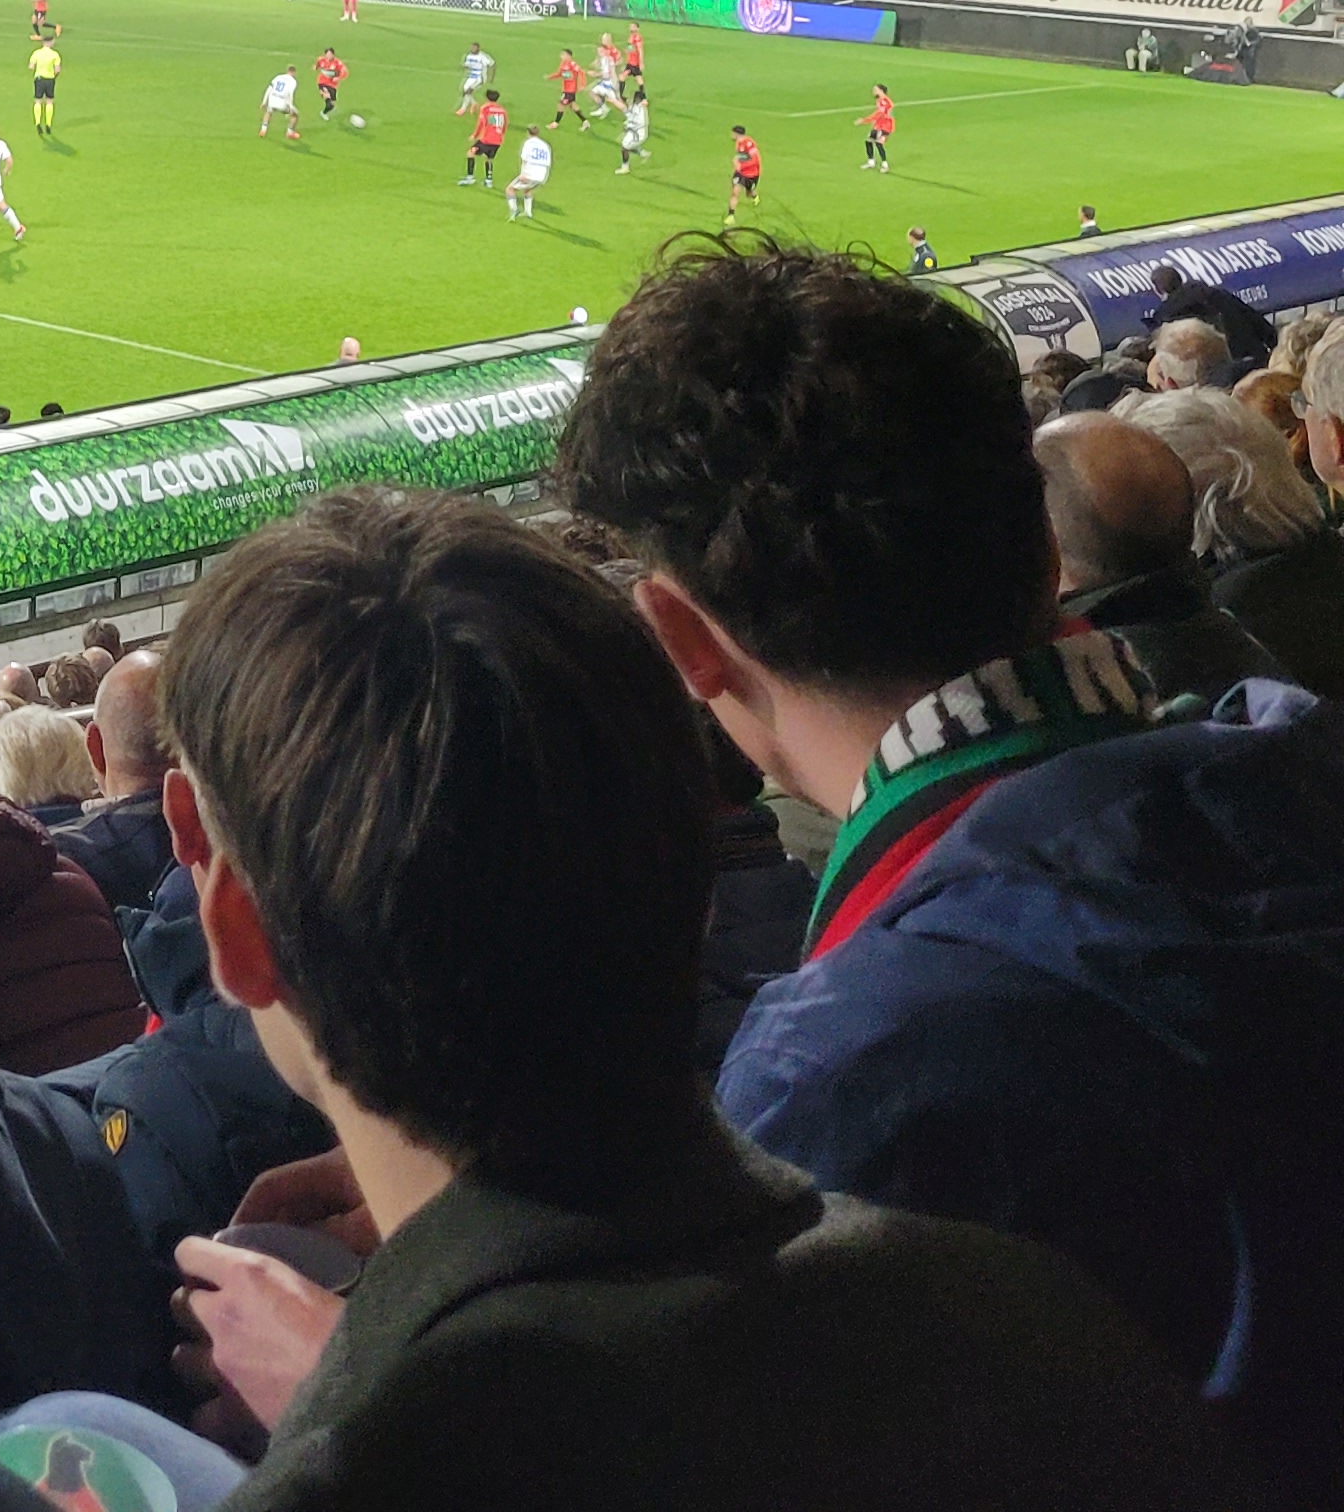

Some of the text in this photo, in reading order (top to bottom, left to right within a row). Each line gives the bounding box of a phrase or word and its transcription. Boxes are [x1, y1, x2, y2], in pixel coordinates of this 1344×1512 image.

[1207, 237, 1282, 276] MATERS
[993, 287, 1071, 316] ARSENAAL
[212, 477, 320, 511] changes your energy
